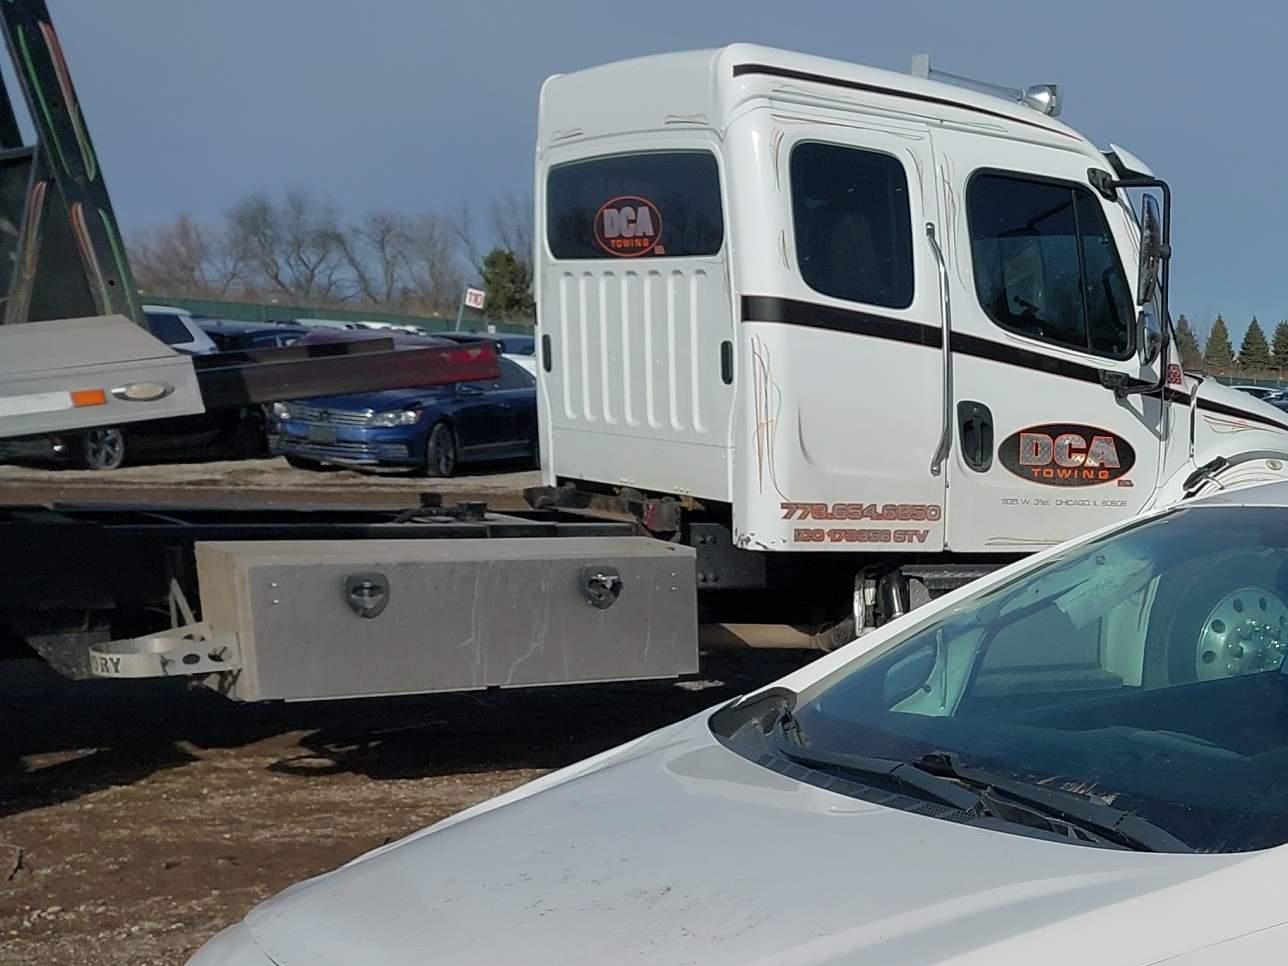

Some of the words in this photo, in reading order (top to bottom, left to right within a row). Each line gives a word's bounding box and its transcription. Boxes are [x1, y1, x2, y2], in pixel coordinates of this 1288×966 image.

[603, 206, 655, 238] DCA
[610, 238, 649, 249] TOWING
[1019, 432, 1121, 468] DCA
[1031, 468, 1110, 480] TOWING
